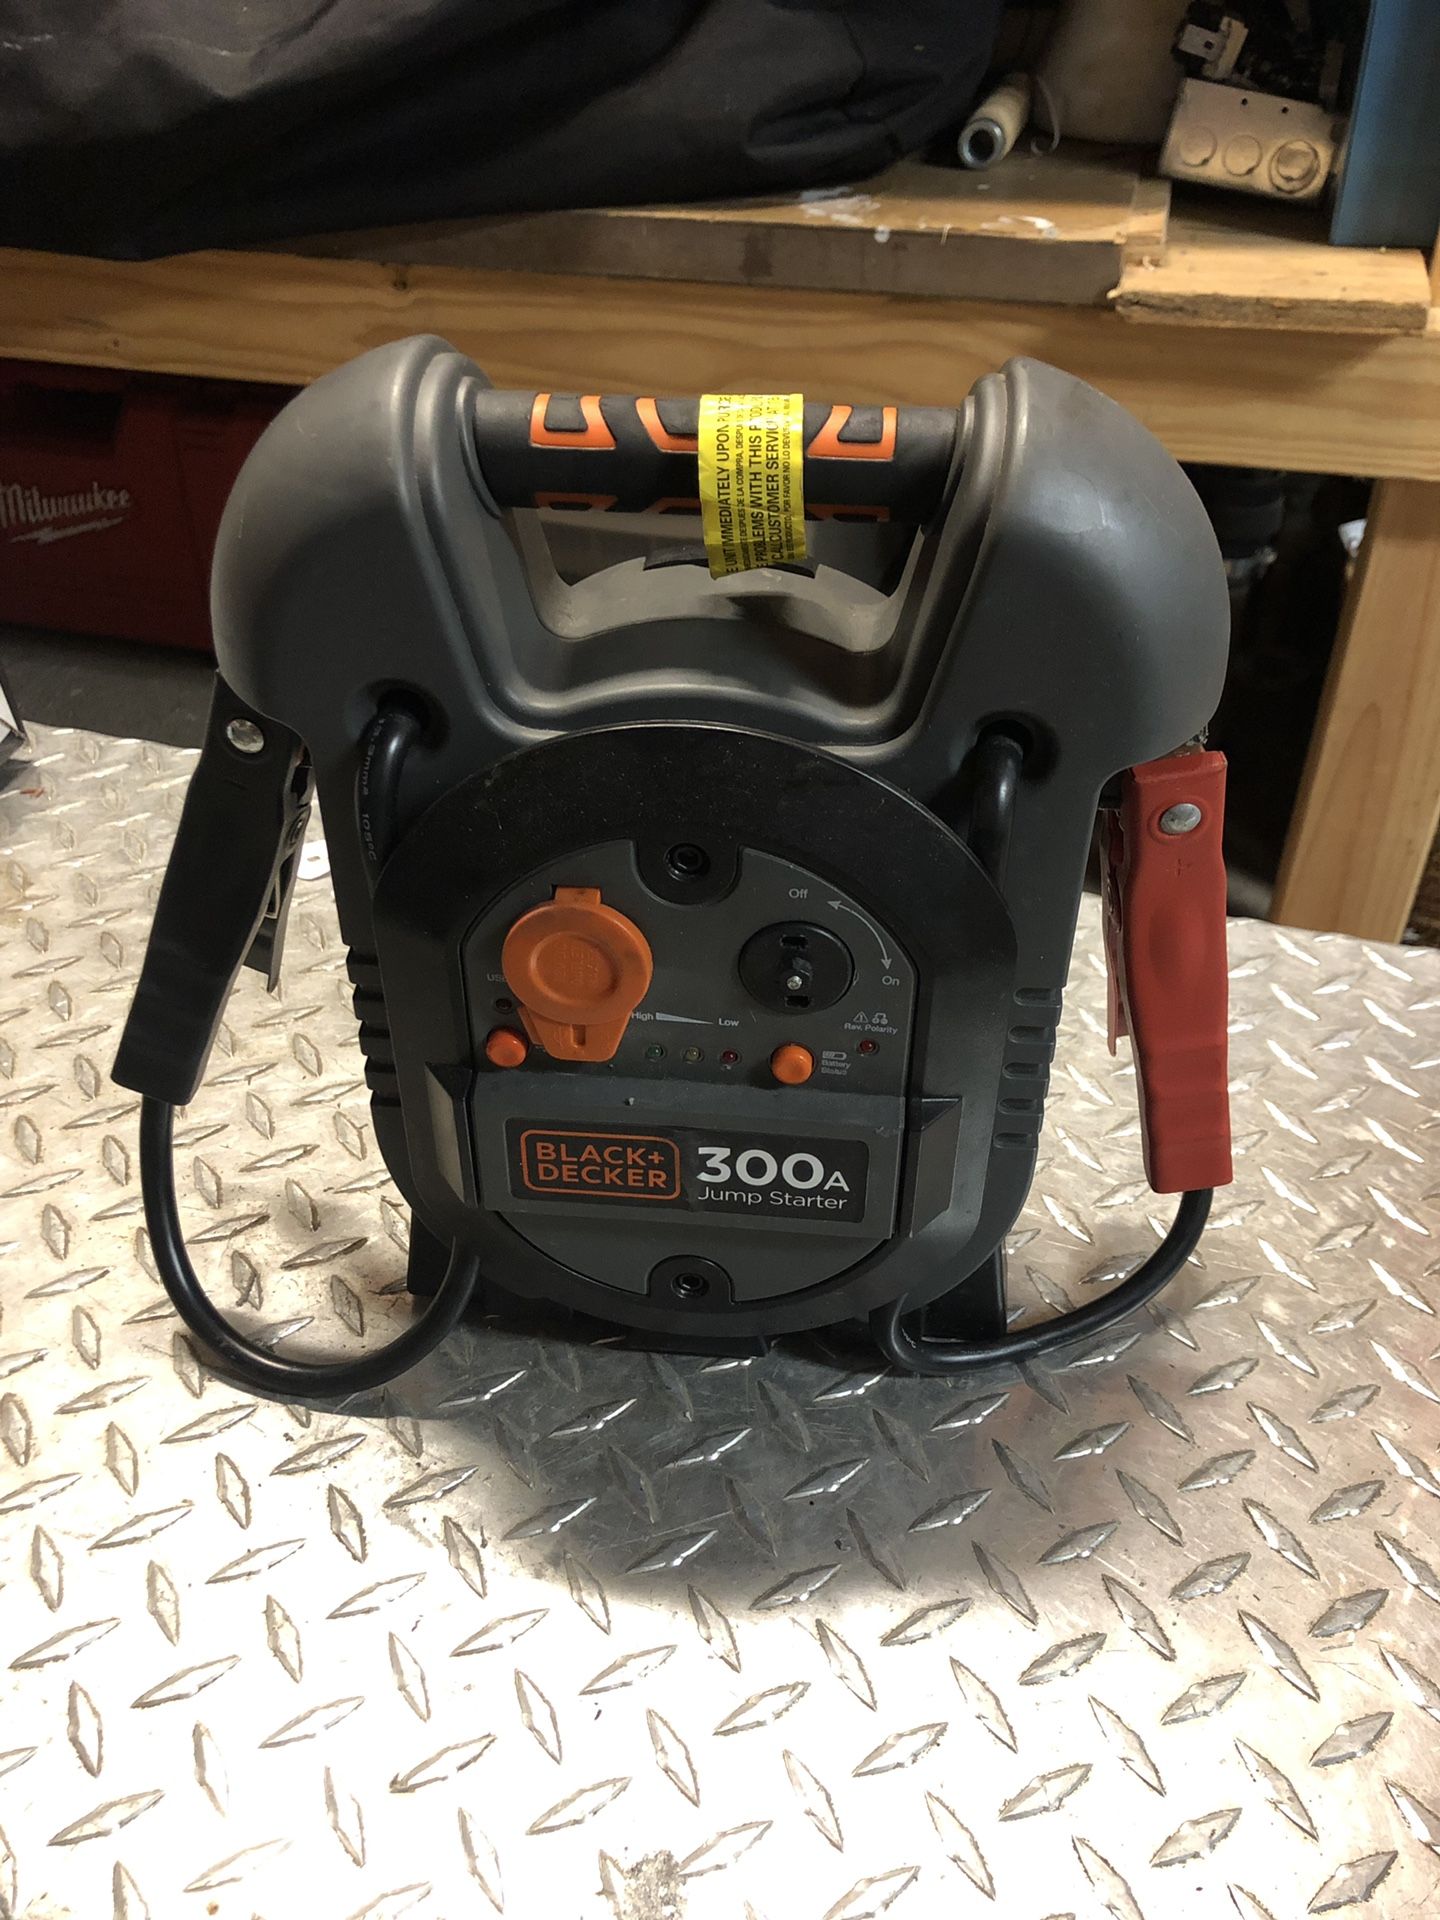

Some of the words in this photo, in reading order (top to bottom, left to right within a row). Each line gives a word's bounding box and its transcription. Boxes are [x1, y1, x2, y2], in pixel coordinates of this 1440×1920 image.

[716, 424, 730, 463] UPON
[748, 435, 763, 468] THIS
[765, 418, 779, 470] SERVIC
[782, 450, 791, 460] LO
[782, 461, 791, 473] NO
[736, 487, 745, 497] LA
[749, 472, 763, 508] WITH
[782, 474, 791, 498] FAVOR
[716, 466, 735, 546] IMMEDIATELY
[766, 474, 782, 542] CUSTOMER
[750, 511, 768, 562] PROBLEMS
[769, 542, 785, 561] CALL
[788, 888, 808, 899] Off
[881, 975, 900, 986] On
[631, 1011, 654, 1022] High
[718, 1017, 740, 1027] Low
[844, 1022, 863, 1032] Rev.
[865, 1024, 898, 1035] Polarity
[821, 1059, 851, 1069] Battery
[535, 1142, 665, 1166] BLACK+
[538, 1163, 668, 1188] DECKER
[696, 1146, 850, 1193] 300A
[697, 1186, 762, 1206] Jump
[769, 1190, 848, 1210] Starter
